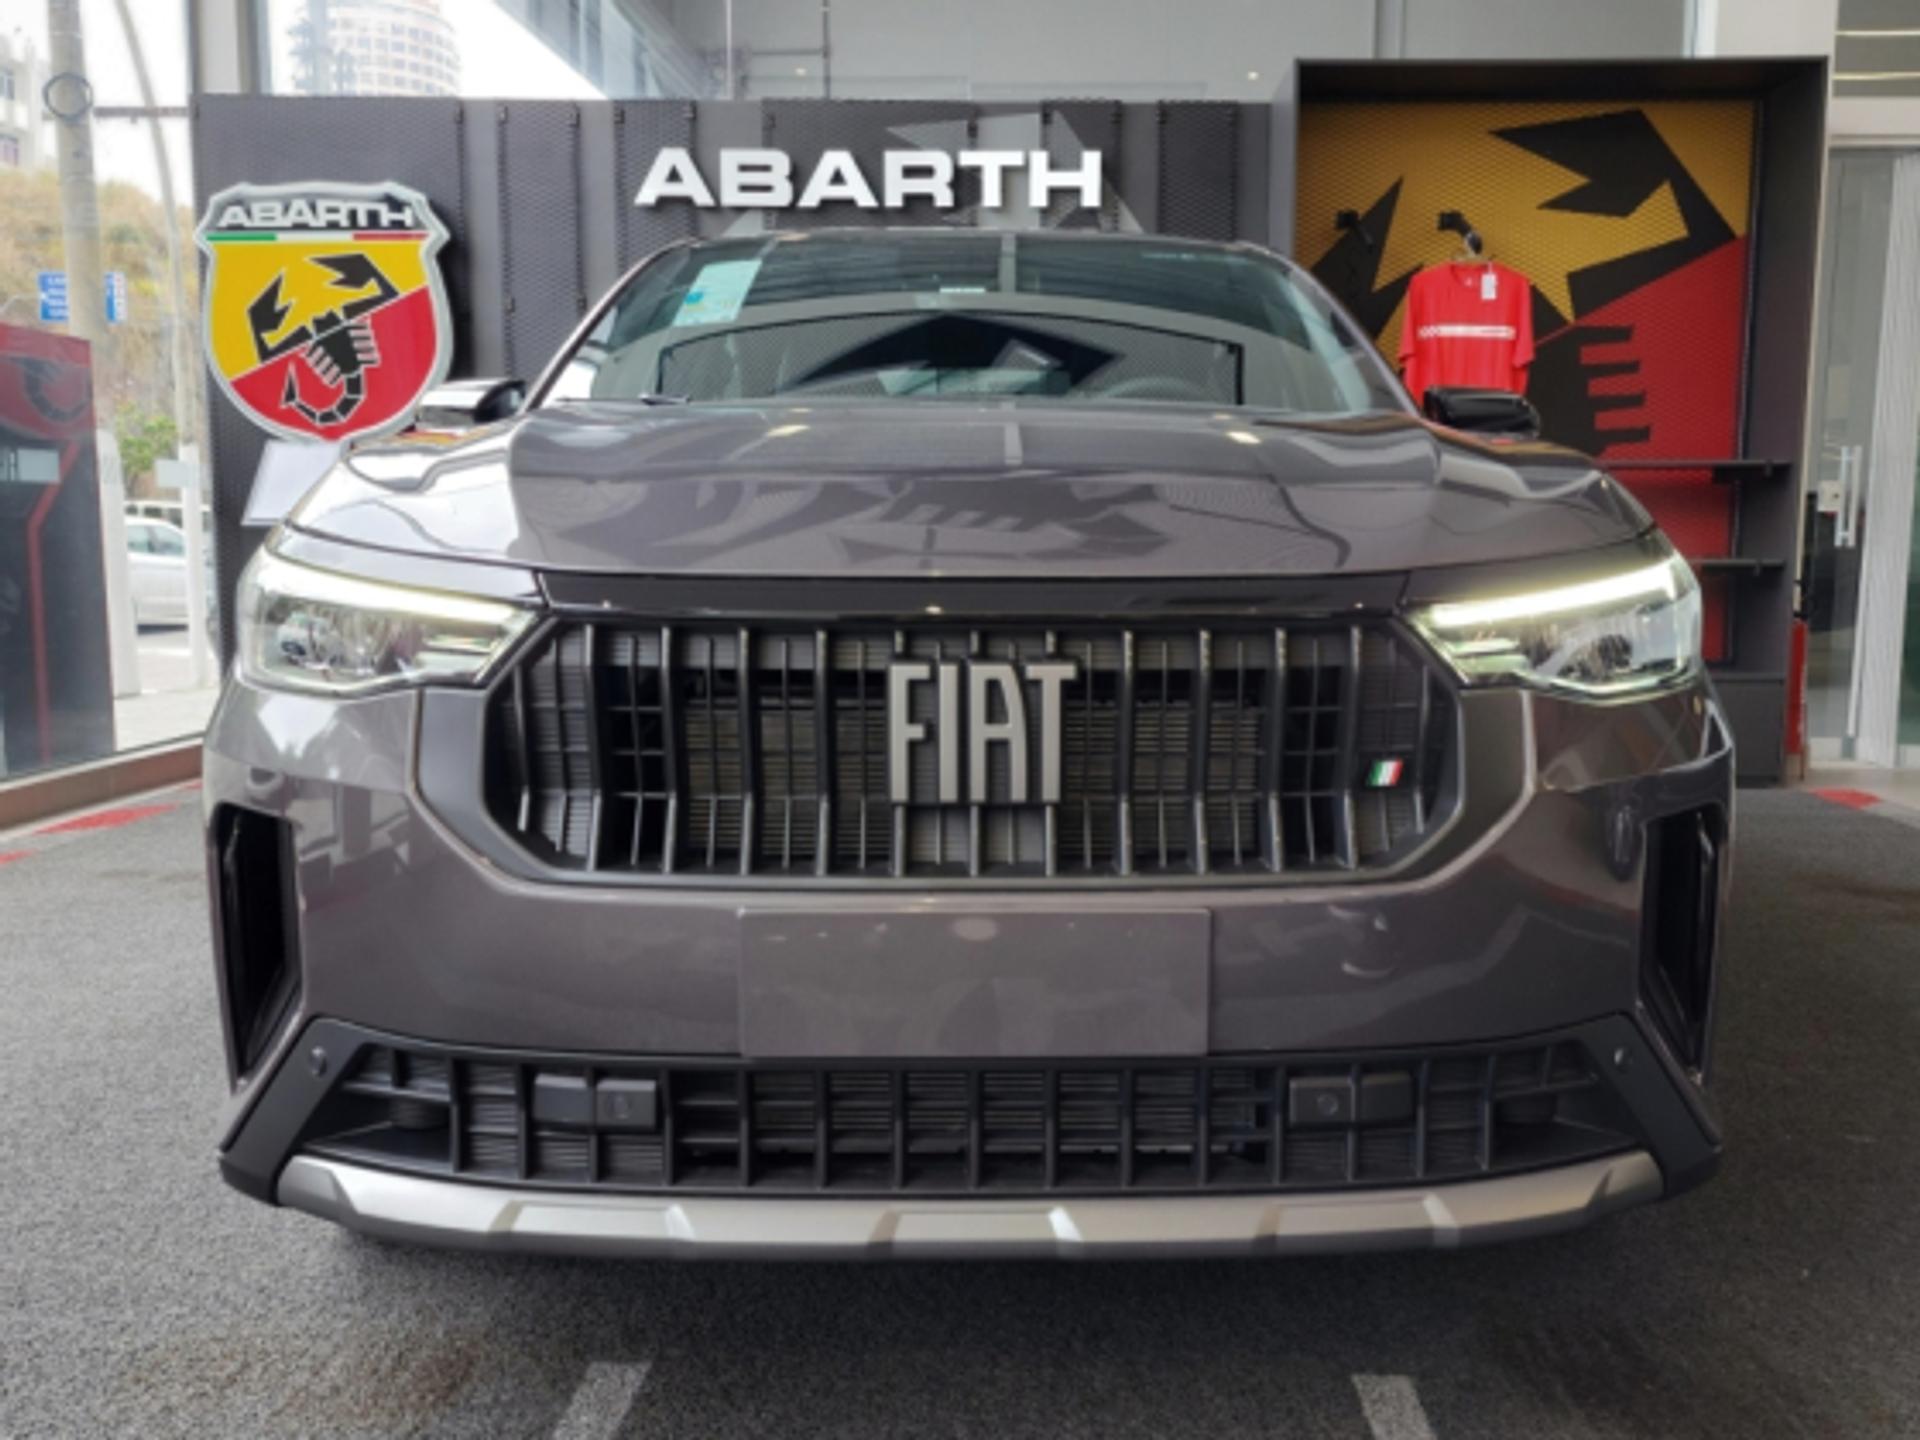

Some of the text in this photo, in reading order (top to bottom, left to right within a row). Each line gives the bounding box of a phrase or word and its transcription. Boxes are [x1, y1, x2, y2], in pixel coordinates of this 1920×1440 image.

[634, 147, 1102, 207] ABARTH
[217, 199, 414, 228] ABARTH
[890, 664, 1076, 803] FIAT
